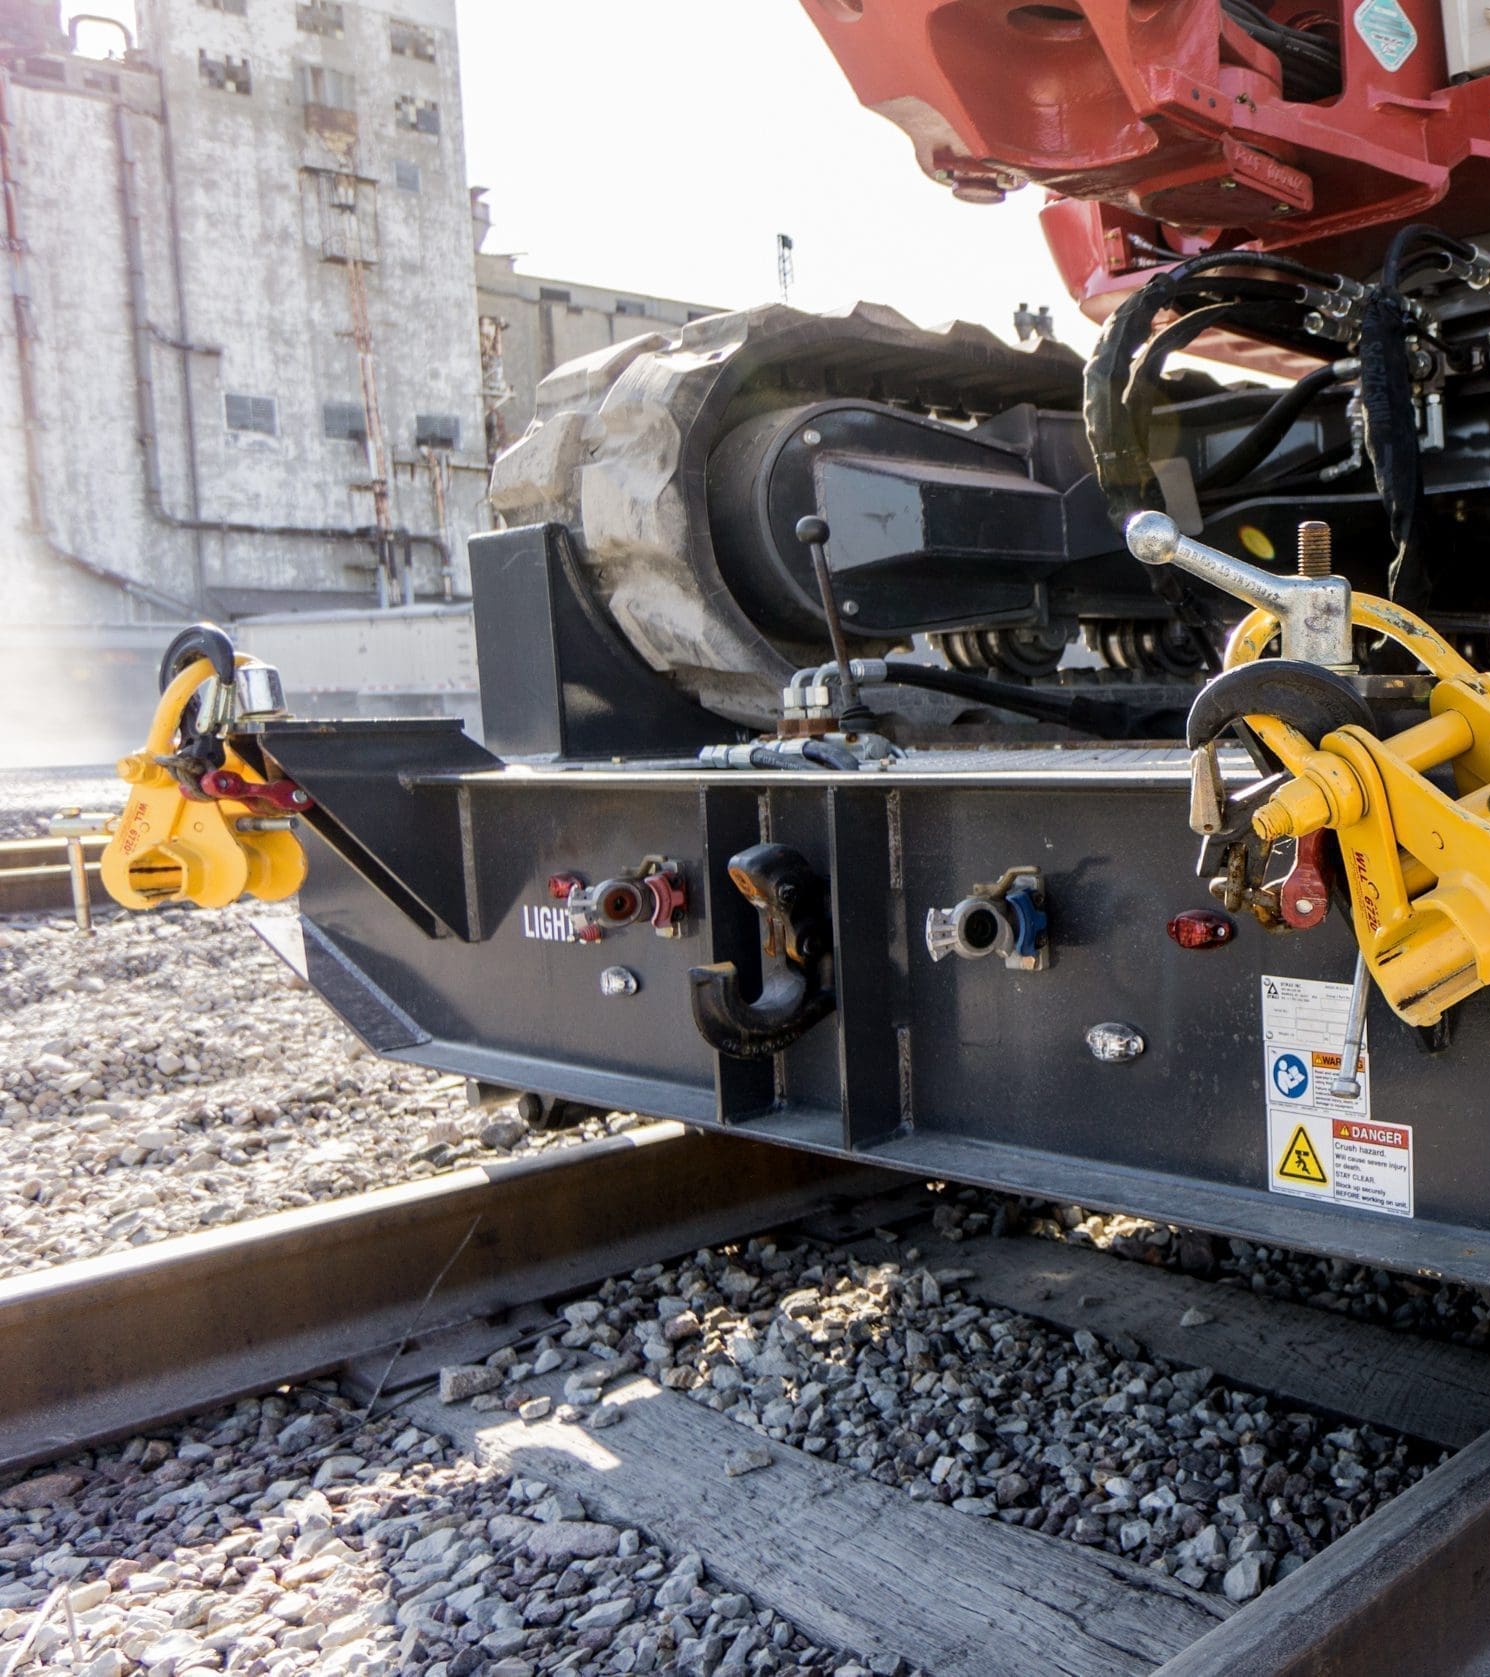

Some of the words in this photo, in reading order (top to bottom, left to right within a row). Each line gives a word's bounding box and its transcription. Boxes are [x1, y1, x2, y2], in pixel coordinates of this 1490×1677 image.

[135, 802, 148, 821] WLL
[1355, 851, 1368, 882] WLL
[1364, 895, 1377, 932] 6720
[1322, 1056, 1363, 1069] WARG
[1352, 1126, 1402, 1145] DANGER
[1335, 1142, 1357, 1153] Crush
[1360, 1146, 1386, 1157] hazard.
[1348, 1156, 1365, 1164] cause
[1367, 1159, 1387, 1168] severe
[1389, 1162, 1407, 1172] injury
[1362, 1186, 1386, 1196] securely
[1362, 1195, 1384, 1205] working
